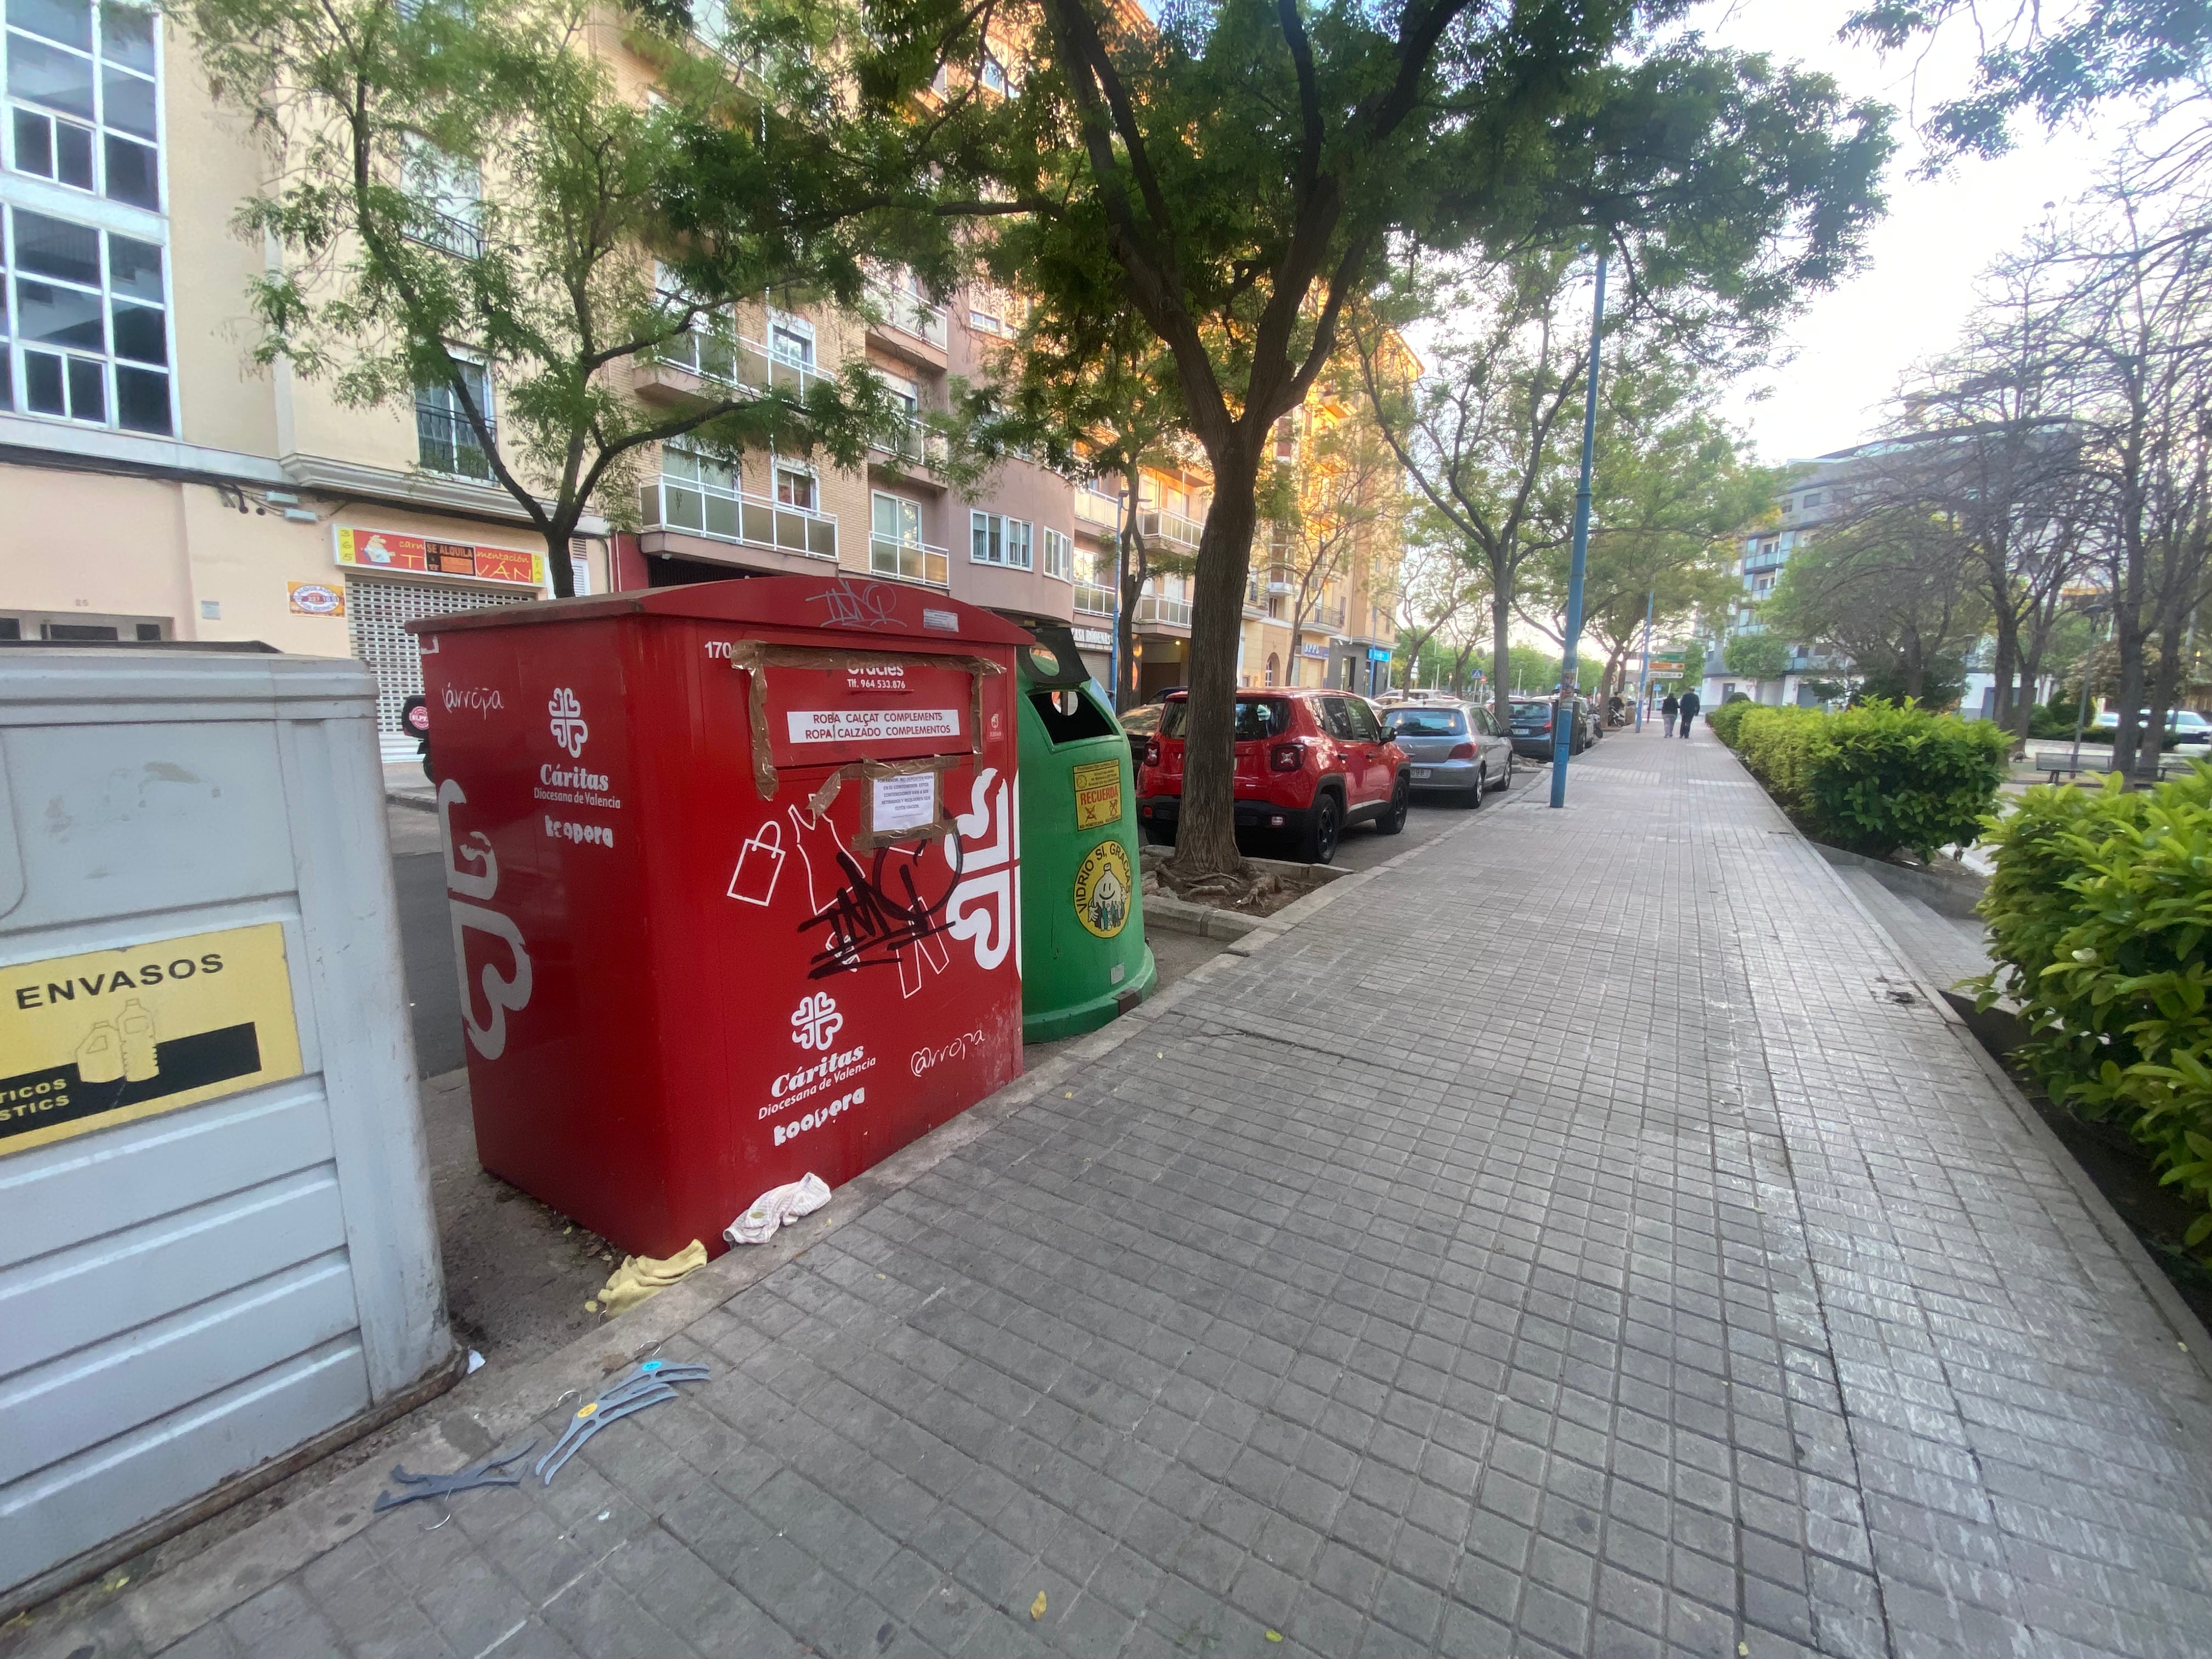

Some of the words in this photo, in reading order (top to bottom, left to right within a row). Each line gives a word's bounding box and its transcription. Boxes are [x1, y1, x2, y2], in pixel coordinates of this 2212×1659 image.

[399, 540, 424, 550] carn
[476, 551, 529, 563] mentación
[426, 544, 437, 554] SE
[439, 544, 473, 558] ALQUILA
[704, 641, 732, 658] 170
[813, 714, 841, 724] ROBA
[846, 713, 879, 726] CALÇAT
[884, 712, 943, 722] COMPLEMENTS
[805, 729, 832, 739] ROPA
[838, 727, 881, 738] CALZADO
[886, 725, 951, 736] COMPLEMENTOS
[540, 763, 608, 791] Cáritas
[534, 787, 572, 803] Diocesana
[574, 791, 584, 804] de
[585, 791, 620, 809] Valencia
[1080, 785, 1119, 805] RECUERDA
[1076, 860, 1094, 914] VIDRIO
[1095, 845, 1108, 861] SI,
[1109, 843, 1131, 894] GRACIAS
[16, 953, 224, 1010] ENVASOS
[771, 1045, 865, 1098] Cáritas
[758, 1085, 817, 1120] Diocesana
[819, 1077, 832, 1091] de
[833, 1057, 876, 1084] Valencia
